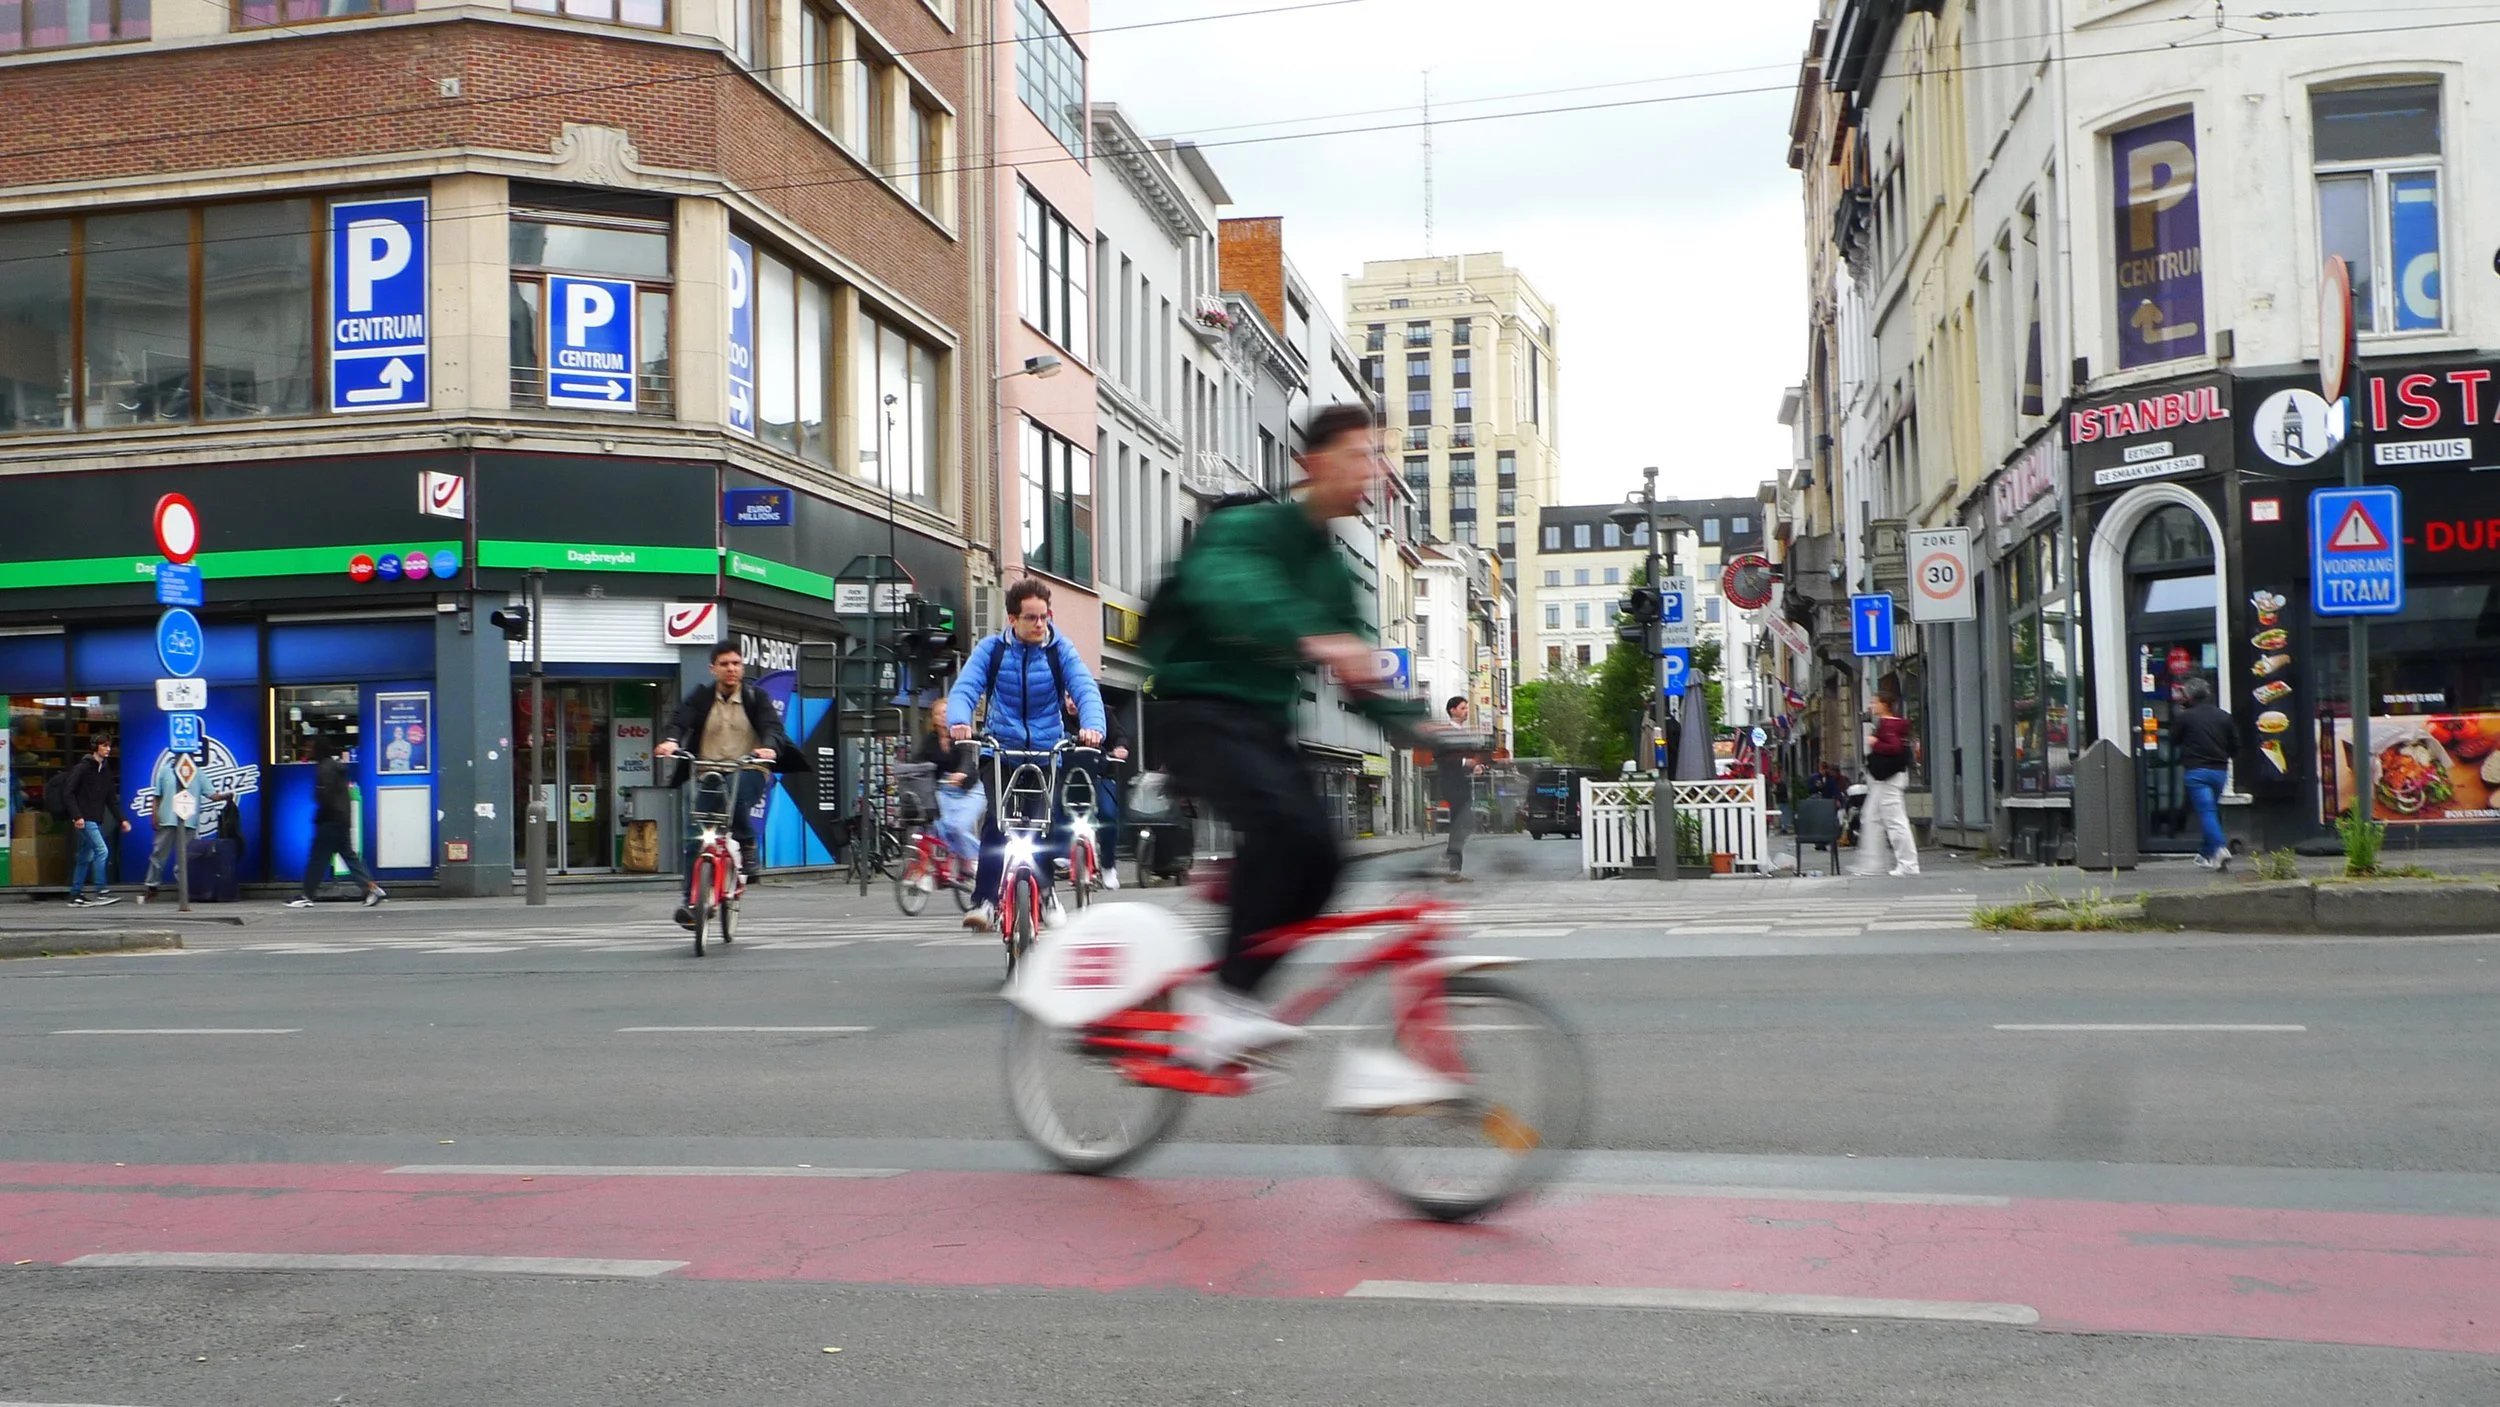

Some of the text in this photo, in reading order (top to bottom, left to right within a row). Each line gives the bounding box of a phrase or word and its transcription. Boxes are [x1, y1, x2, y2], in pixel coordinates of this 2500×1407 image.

[2128, 139, 2195, 251] P
[347, 217, 412, 313] P
[566, 284, 615, 347] P
[336, 314, 424, 343] CENTRUM
[558, 349, 625, 371] CENTRUM
[2370, 369, 2500, 432] IST
[2070, 386, 2230, 444] ISTANBUL
[2127, 446, 2166, 460] EETHUIS
[2382, 442, 2465, 462] EETHUIS
[2098, 472, 2110, 483] DE
[2112, 468, 2142, 481] SMAAK
[2144, 463, 2162, 475] VAN
[2174, 457, 2198, 470] STAD
[738, 512, 781, 521] MILLIONS
[746, 505, 772, 513] EURO
[1921, 535, 1956, 547] ZONE
[567, 549, 636, 566] Dagbreydel
[2323, 557, 2394, 575] VOORRANG
[1928, 566, 1954, 584] 30
[1661, 580, 1687, 591] ONE
[2328, 578, 2391, 604] TRAM
[1663, 594, 1678, 616] P
[1663, 655, 1684, 689] P
[174, 717, 193, 735] 25
[617, 724, 650, 738] Lotto
[624, 759, 644, 767] EURO
